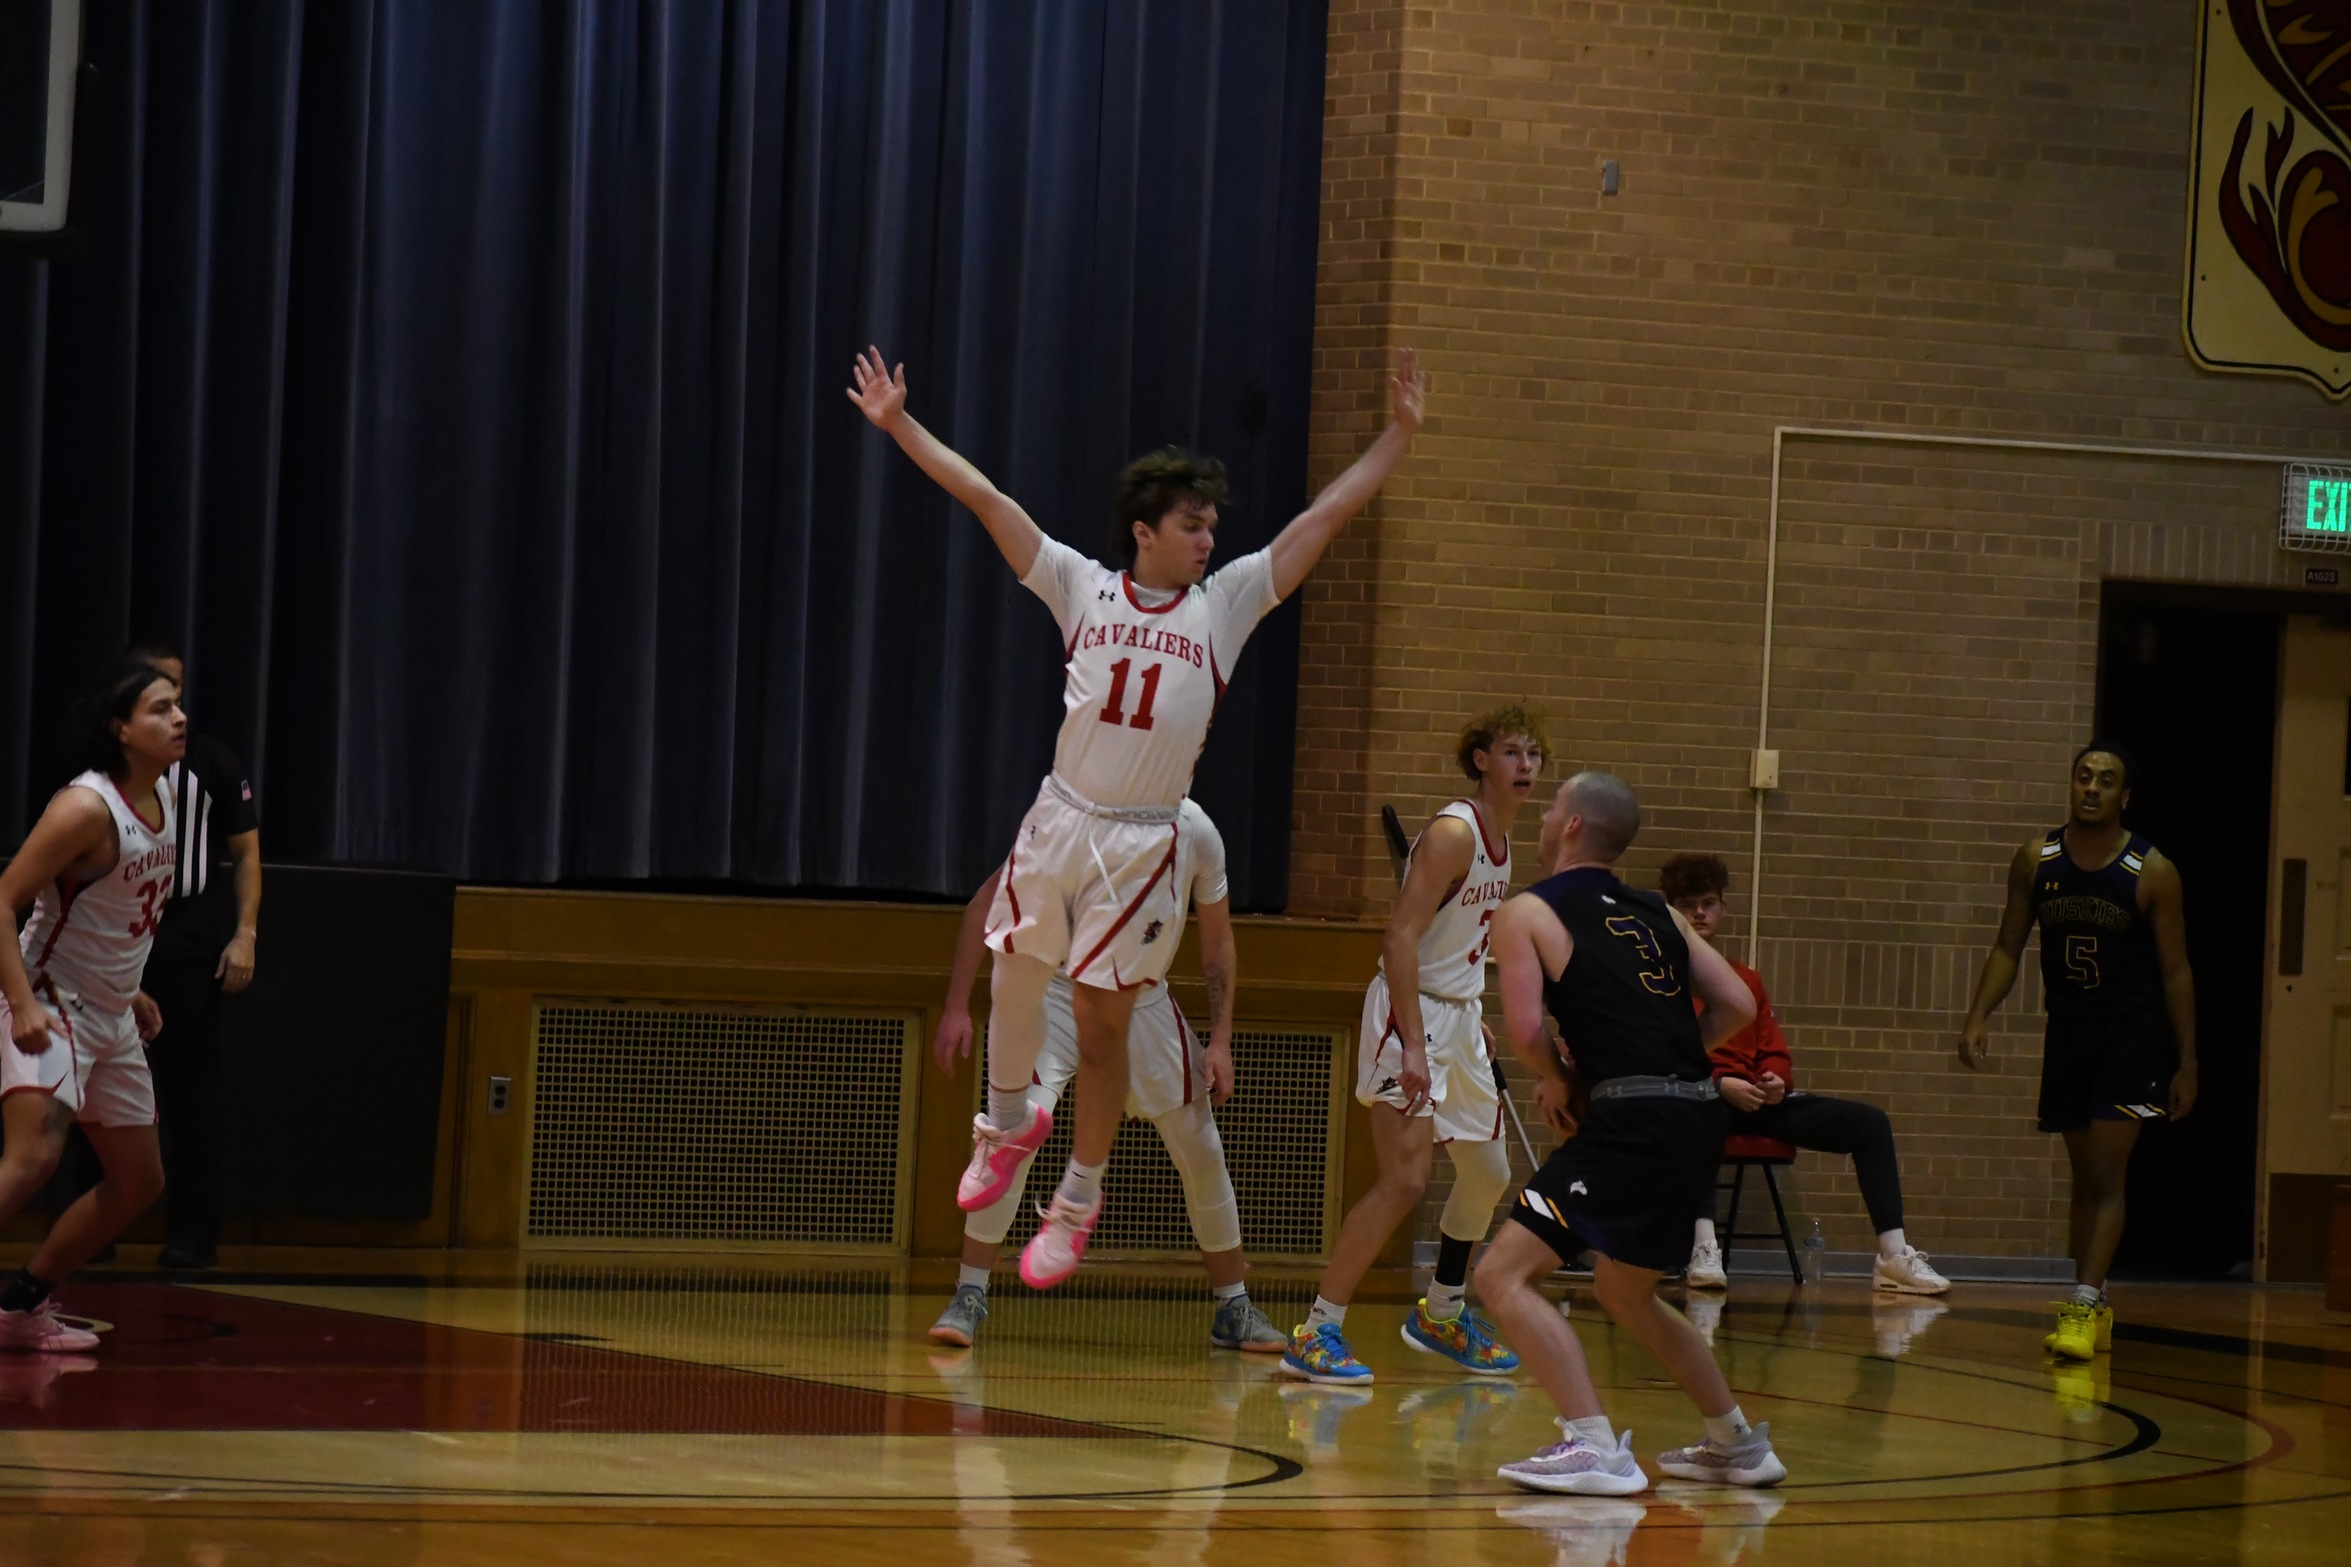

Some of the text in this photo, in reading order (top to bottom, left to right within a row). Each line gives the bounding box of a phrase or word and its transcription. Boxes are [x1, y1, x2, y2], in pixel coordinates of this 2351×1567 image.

[2306, 479, 2351, 532] EXI
[1084, 623, 1203, 669] CAVALIERS
[1100, 657, 1162, 731] 11
[1605, 916, 1681, 996] 3
[2065, 935, 2100, 990] 5
